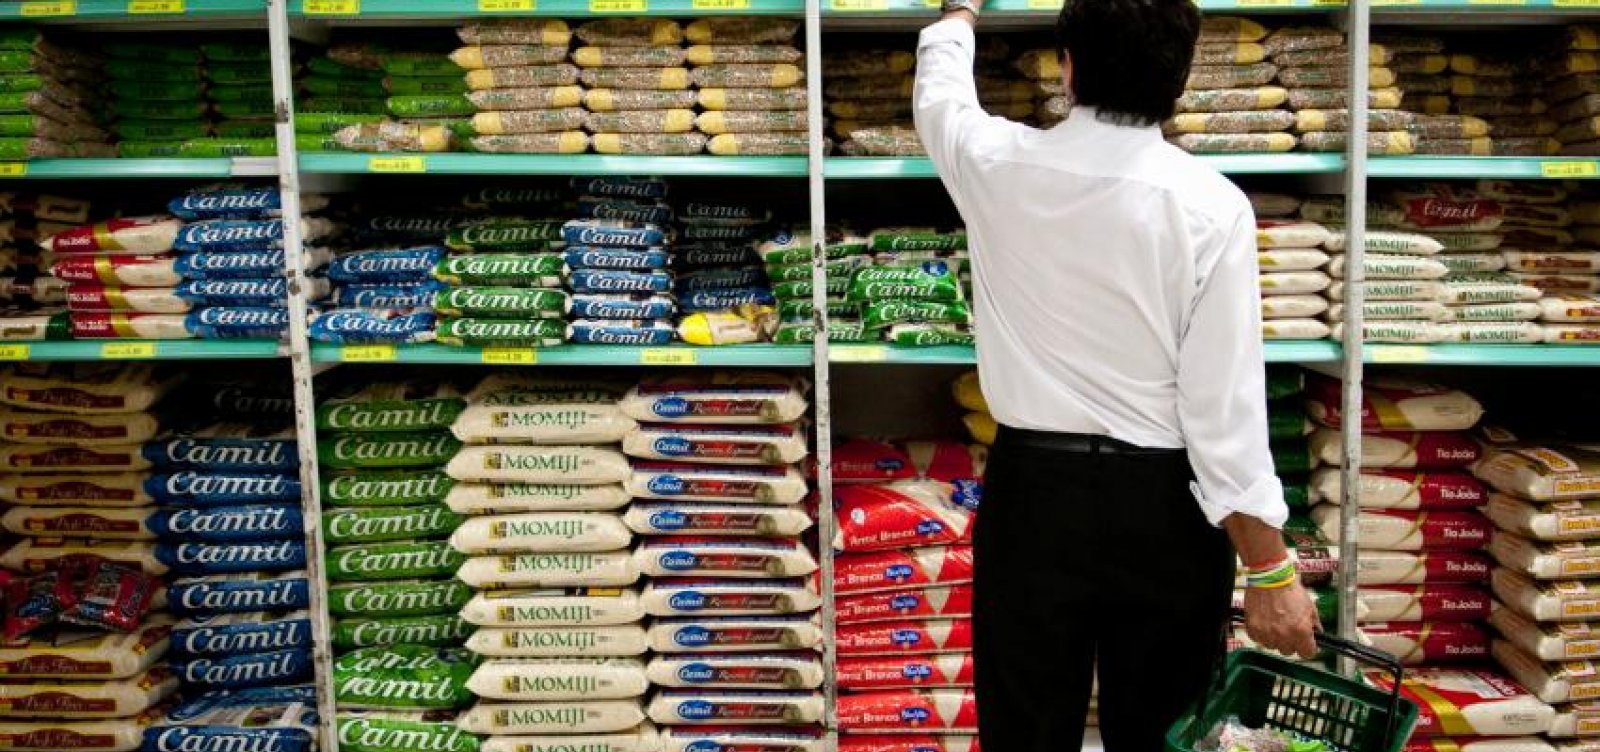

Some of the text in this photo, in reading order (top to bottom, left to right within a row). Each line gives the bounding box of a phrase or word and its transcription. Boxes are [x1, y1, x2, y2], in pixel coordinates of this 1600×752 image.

[183, 190, 270, 209] Camil
[186, 221, 280, 243] Camil
[463, 220, 550, 244] Camil
[580, 228, 647, 246] Camil
[190, 250, 284, 269] Camil
[343, 252, 430, 274] Camil
[449, 255, 543, 275] Camil
[582, 251, 650, 267] Camil
[190, 278, 285, 296] Camil
[587, 273, 655, 291] Camil
[866, 282, 936, 298] Camil
[451, 290, 543, 311] Camil
[587, 301, 652, 318] Camil
[326, 315, 417, 335] Camil
[452, 318, 545, 338] Camil
[589, 326, 656, 344] Camil
[329, 402, 446, 428] Camil
[511, 410, 587, 429] MOMIJI
[167, 438, 285, 465] Camil
[335, 436, 447, 460] Camil
[505, 454, 580, 473] MOMIJI
[167, 471, 286, 496] Camil
[329, 474, 441, 500] Camil
[508, 484, 582, 498] MOMIJI
[168, 507, 288, 532] Camil
[330, 508, 443, 537] Camil
[510, 520, 584, 538] MOMIJI
[178, 541, 294, 564] Camil
[339, 544, 453, 573] Camil
[518, 554, 593, 573] MOMIJI
[848, 573, 883, 584] Branco
[182, 582, 297, 609] Camil
[344, 584, 458, 612] Camil
[517, 605, 592, 623] MOMIJI
[186, 621, 301, 654] Camil
[353, 617, 467, 647] Camil
[522, 631, 596, 651] MOMIJI
[186, 652, 296, 684] Camil
[522, 675, 597, 694] MOMIJI
[511, 708, 586, 727] MOMIJI
[158, 726, 282, 752] Camil
[339, 719, 462, 752] Camil
